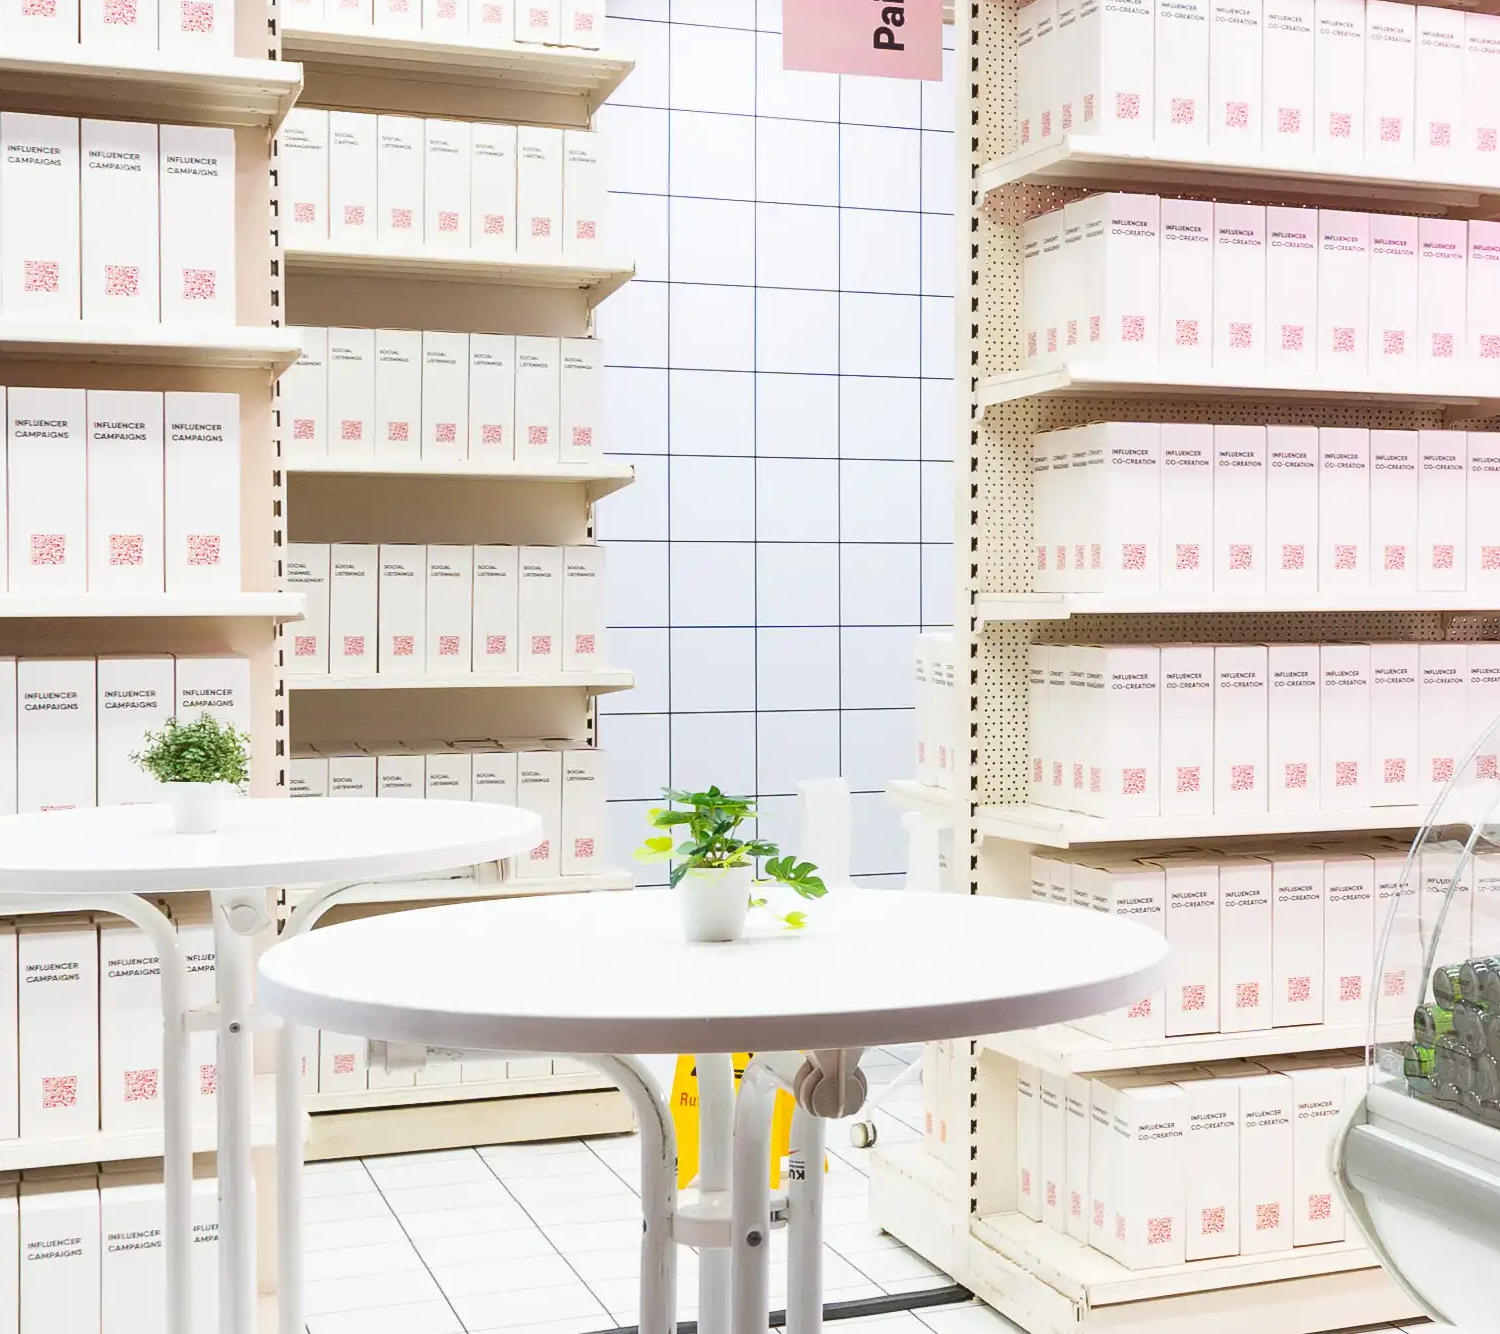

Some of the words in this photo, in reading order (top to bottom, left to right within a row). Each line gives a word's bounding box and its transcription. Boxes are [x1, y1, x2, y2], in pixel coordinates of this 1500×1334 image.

[1105, 5, 1150, 15] CO-CREATION
[166, 156, 218, 165] INFLUENCER
[167, 167, 218, 177] CAMPAIGNS
[1112, 219, 1148, 227] INFLUENCER
[1111, 228, 1156, 237] CO-CREATION
[14, 419, 68, 427] INFLUENCER
[15, 431, 70, 439] CAMPAIGNS
[1171, 891, 1208, 899] INFLUENCER
[1172, 900, 1215, 909] CO-CREATION
[1190, 1112, 1227, 1121] INFLUENCER
[1190, 1121, 1235, 1131] CO-CREATION
